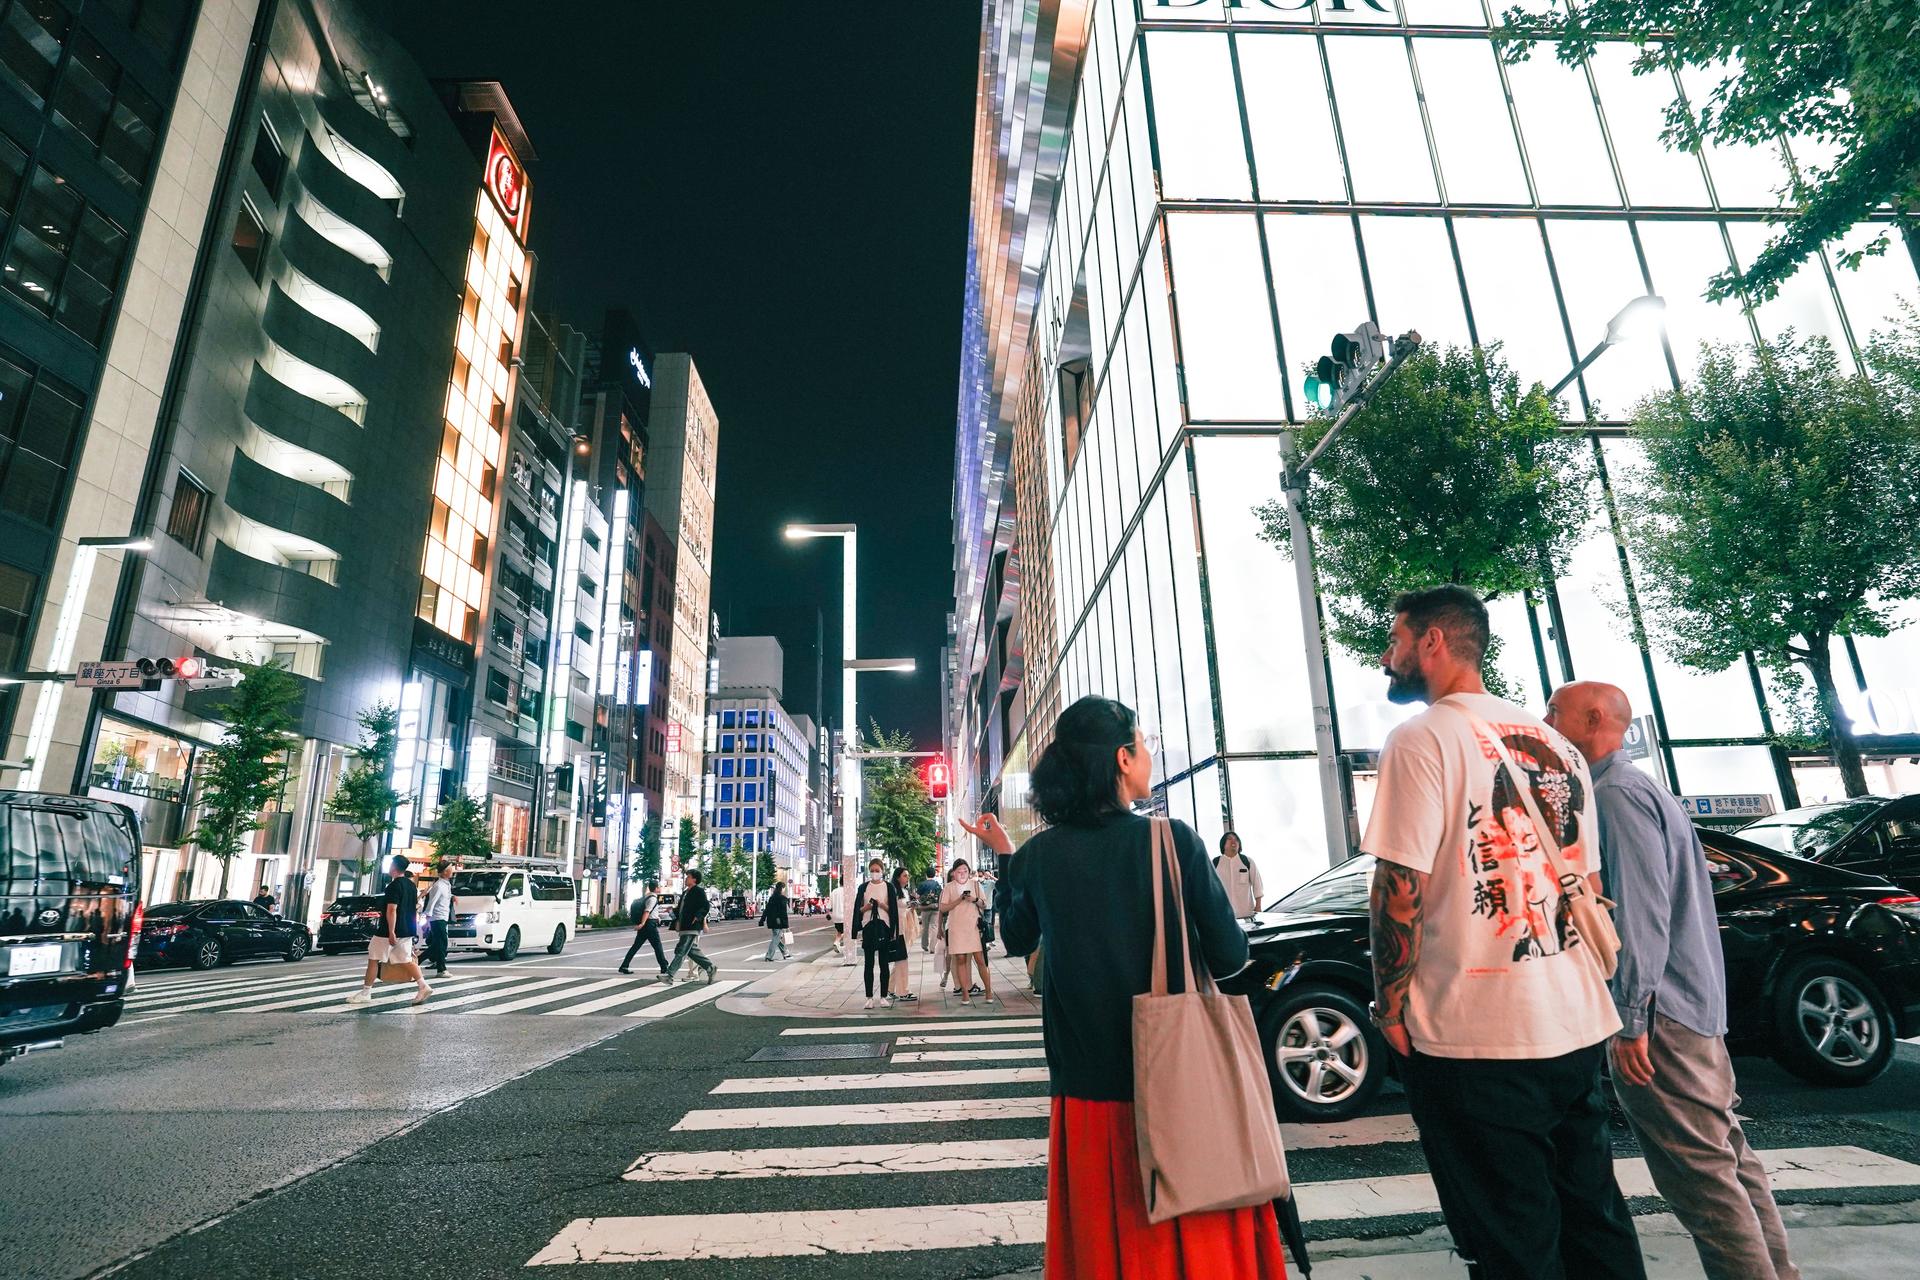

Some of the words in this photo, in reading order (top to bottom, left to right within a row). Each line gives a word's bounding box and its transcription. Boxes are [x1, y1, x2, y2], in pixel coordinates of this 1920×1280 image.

[82, 668, 139, 678] 銀座六丁目
[1715, 796, 1761, 807] 地下鉄銀座駅
[1715, 807, 1736, 815] Subway
[1737, 806, 1753, 814] Ginza
[1467, 799, 1510, 920] と信頼
